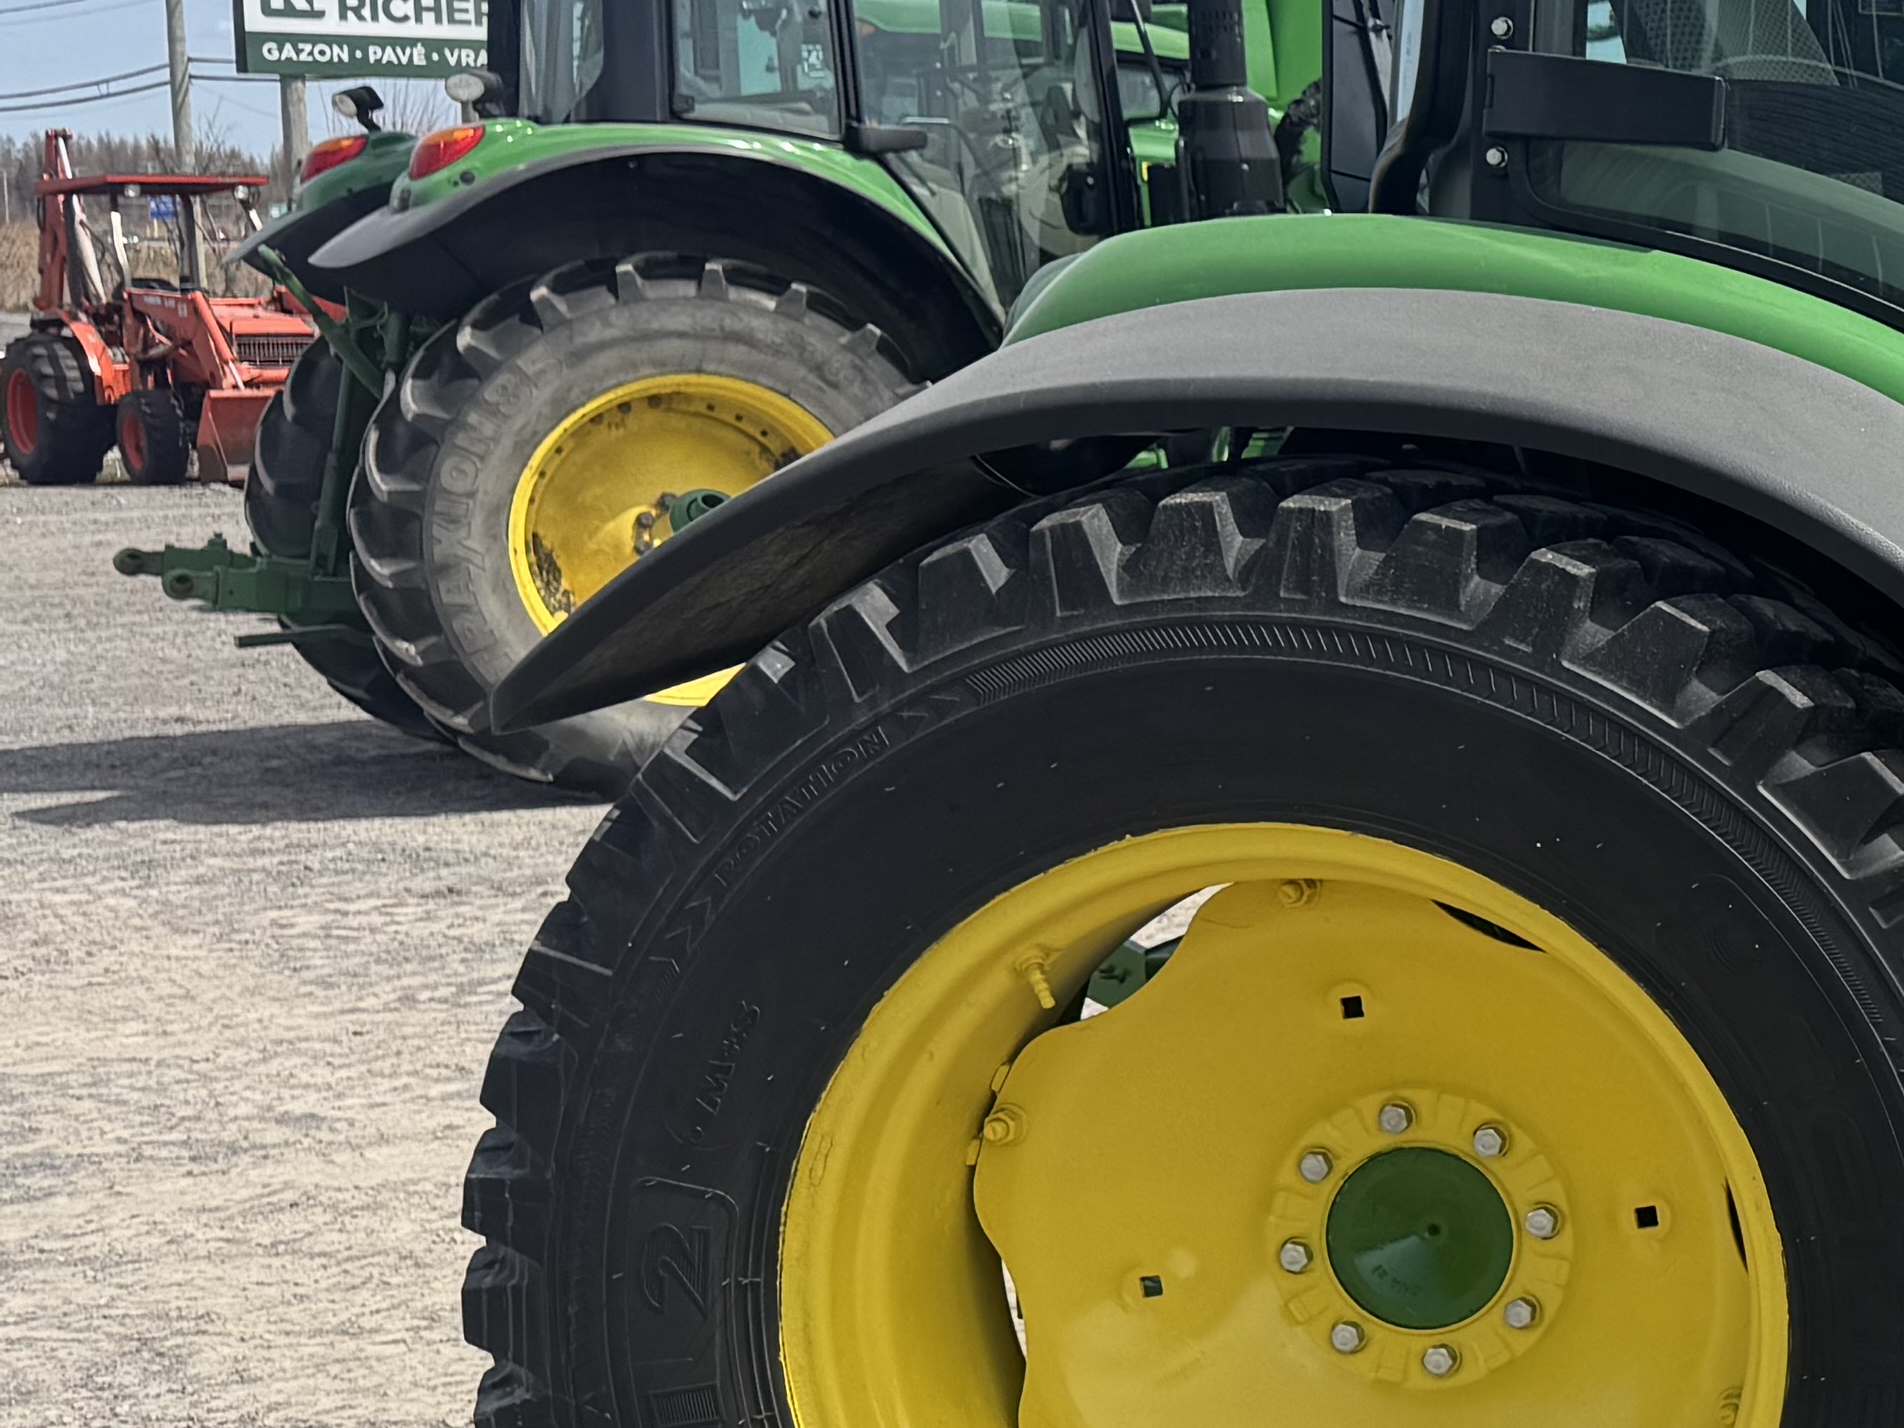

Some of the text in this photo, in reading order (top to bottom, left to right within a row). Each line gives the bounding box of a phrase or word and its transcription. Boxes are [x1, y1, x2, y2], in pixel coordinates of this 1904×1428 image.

[262, 42, 349, 63] GAZON
[368, 42, 427, 65] PAVÉ
[718, 726, 891, 888] ROTATION
[643, 1222, 712, 1313] 2
